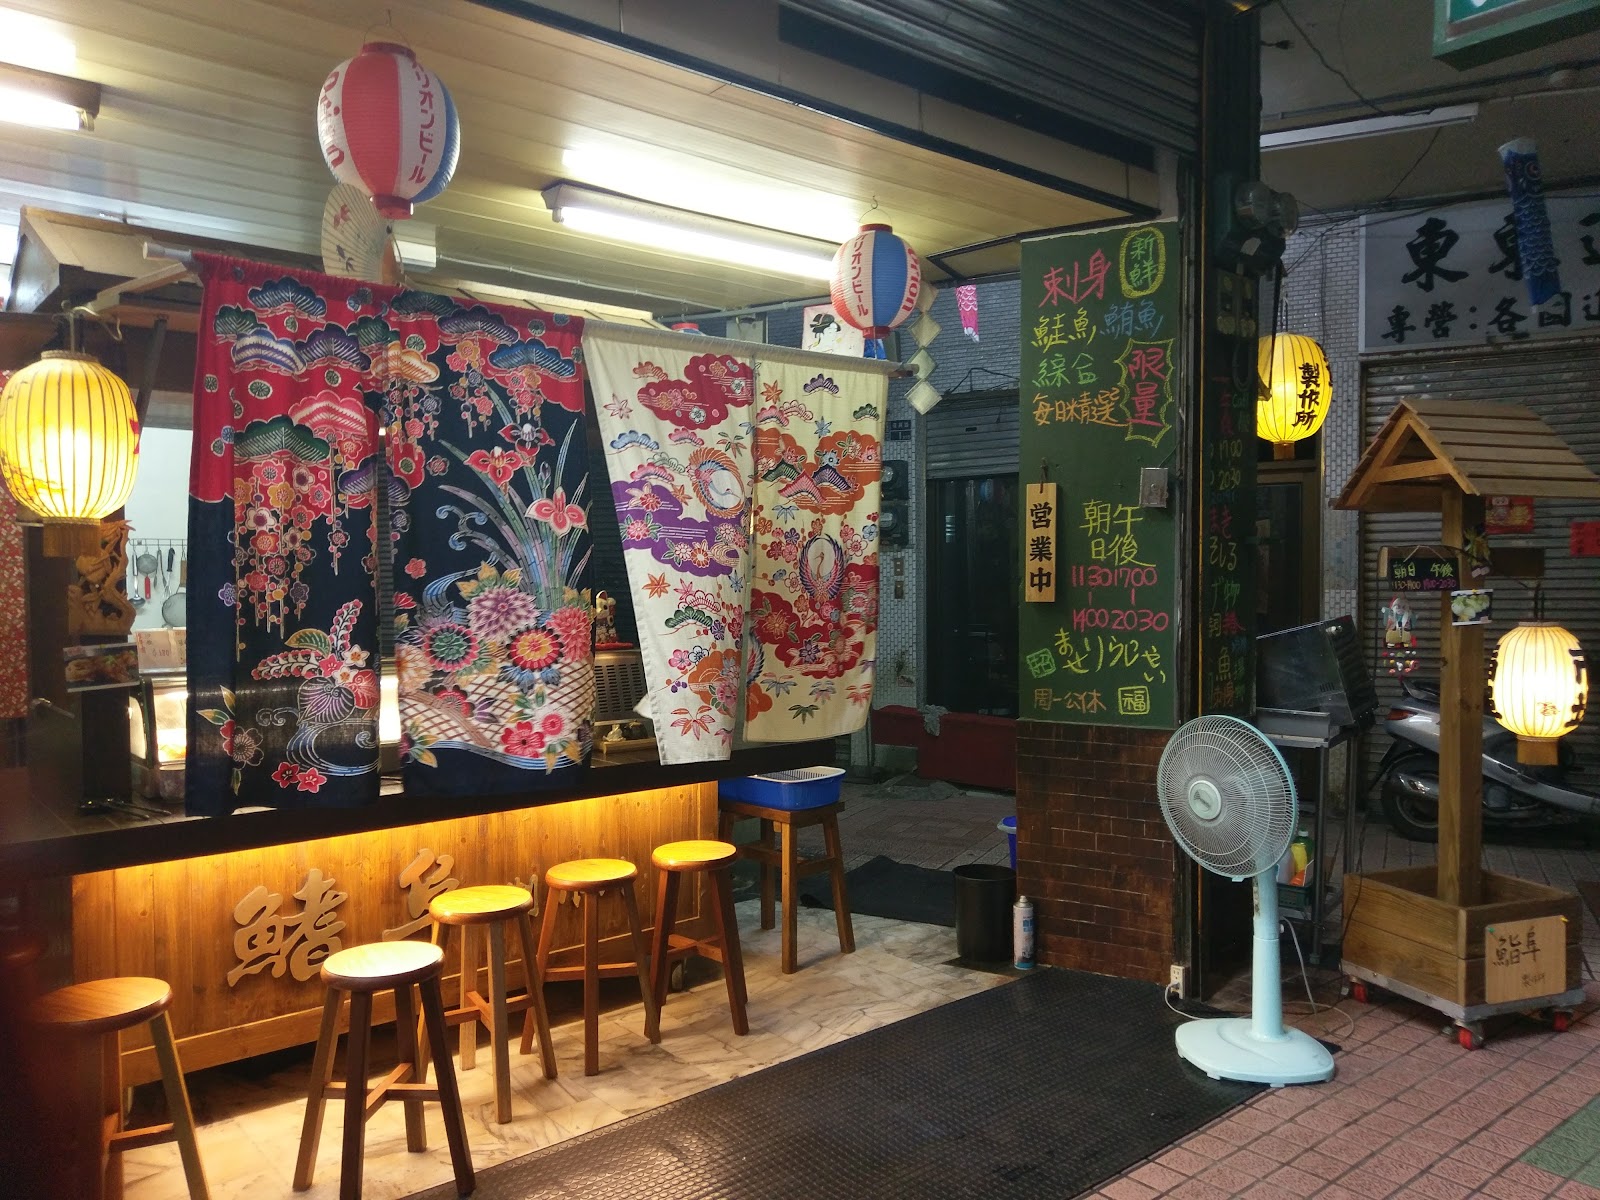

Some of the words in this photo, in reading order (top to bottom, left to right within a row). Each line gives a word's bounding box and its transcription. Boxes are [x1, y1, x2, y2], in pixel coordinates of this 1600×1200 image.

[1128, 233, 1158, 288] 新鮮
[1127, 347, 1165, 427] 限量
[1292, 362, 1320, 431] 製作所
[1030, 503, 1053, 593] 営業中
[1111, 608, 1170, 632] 2030
